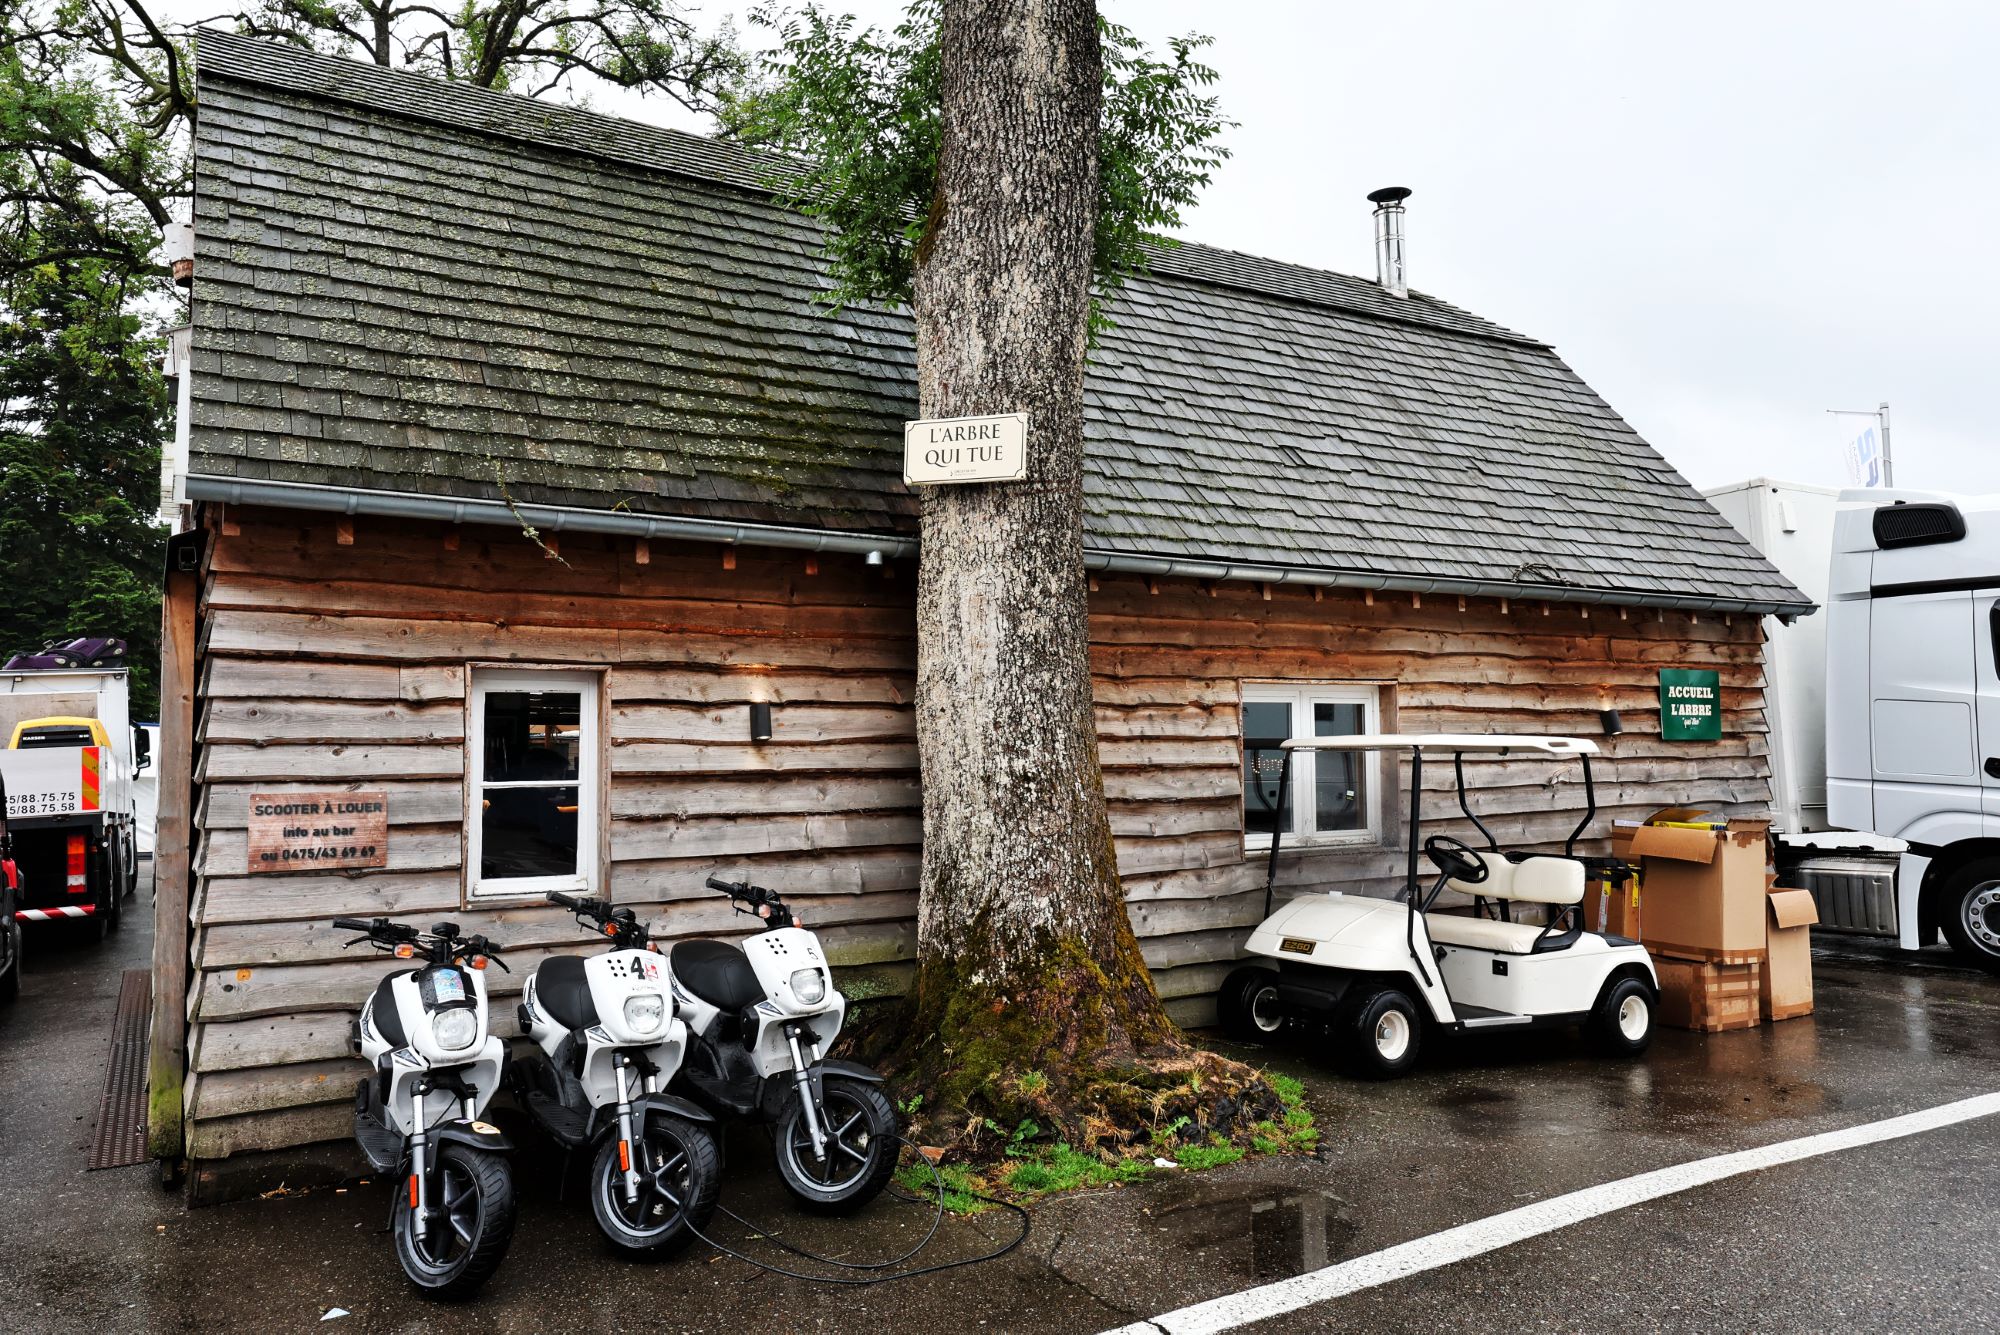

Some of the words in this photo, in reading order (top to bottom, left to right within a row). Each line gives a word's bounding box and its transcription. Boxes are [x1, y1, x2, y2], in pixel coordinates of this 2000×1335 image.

[930, 424, 1001, 443] L'ARBRE
[925, 448, 960, 468] QUI
[966, 445, 1003, 463] TUE
[1668, 685, 1714, 699] ACCUEIL
[1670, 703, 1712, 716] L'ARBRE
[5, 792, 75, 804] 5/88.75.75
[5, 802, 75, 815] 5/88.75.58
[255, 803, 319, 816] SCOOTER
[323, 801, 333, 814] À
[337, 802, 383, 814] LOUER
[283, 827, 308, 838] info
[312, 828, 330, 837] au
[333, 826, 356, 836] bar
[261, 852, 278, 862] ou
[282, 847, 337, 860] 0475/43
[342, 847, 357, 857] 69
[361, 846, 376, 857] 69
[630, 956, 646, 980] 4
